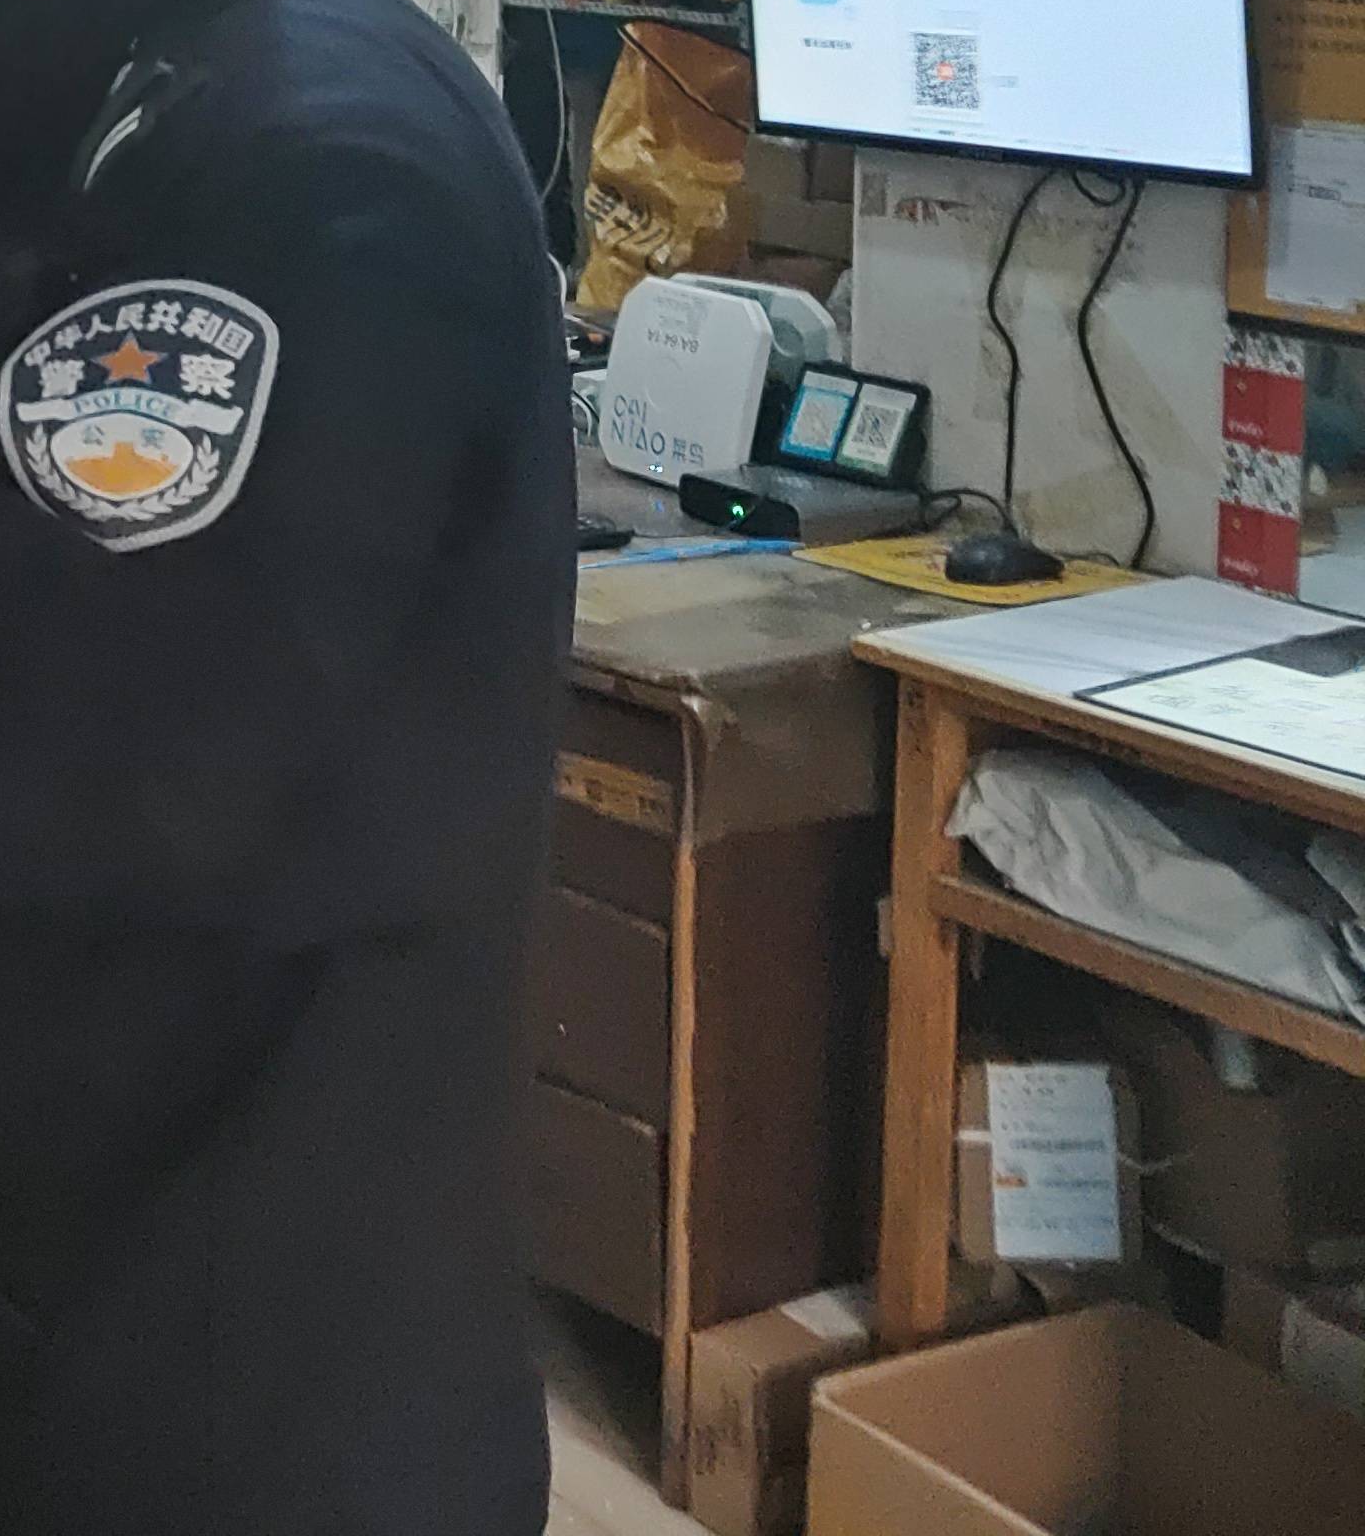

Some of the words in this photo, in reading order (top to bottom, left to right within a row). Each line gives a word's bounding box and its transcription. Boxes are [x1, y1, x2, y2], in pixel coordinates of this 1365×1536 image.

[24, 300, 255, 368] 中华人民共和国
